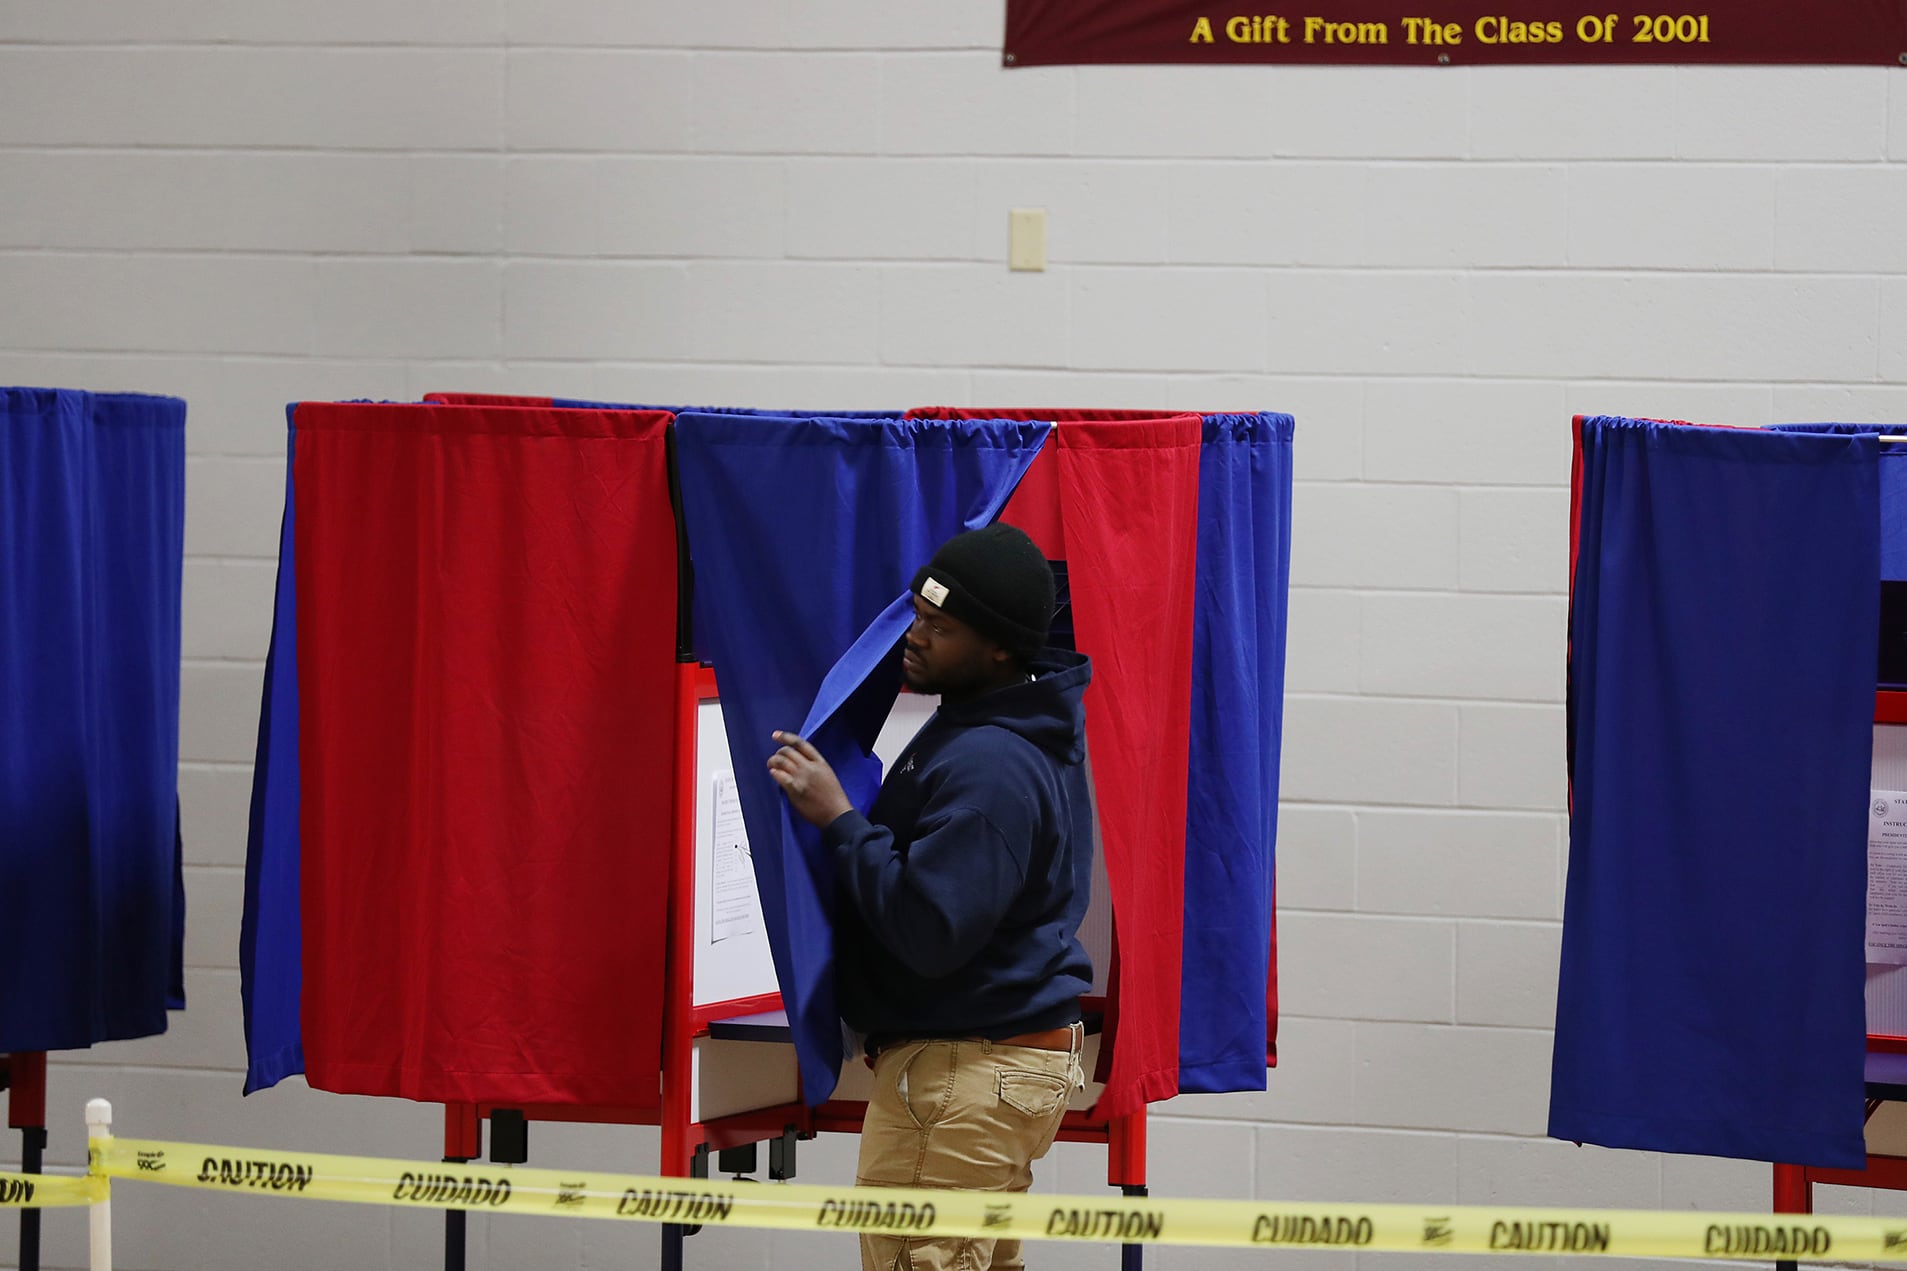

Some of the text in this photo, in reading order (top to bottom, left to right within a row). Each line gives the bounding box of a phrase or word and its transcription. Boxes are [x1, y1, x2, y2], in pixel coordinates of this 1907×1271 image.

[1190, 14, 1710, 45] A Gift From The Class Of 2001
[197, 1157, 313, 1191] CAUTION
[393, 1172, 512, 1206] CUIDADO
[616, 1188, 734, 1221] CAUTION
[817, 1199, 936, 1230] CUIDADO
[1045, 1208, 1163, 1239] CAUTION
[1252, 1214, 1373, 1245] CUIDADO
[1490, 1221, 1610, 1252] CAUTION
[1704, 1224, 1831, 1255] CUIDADO
